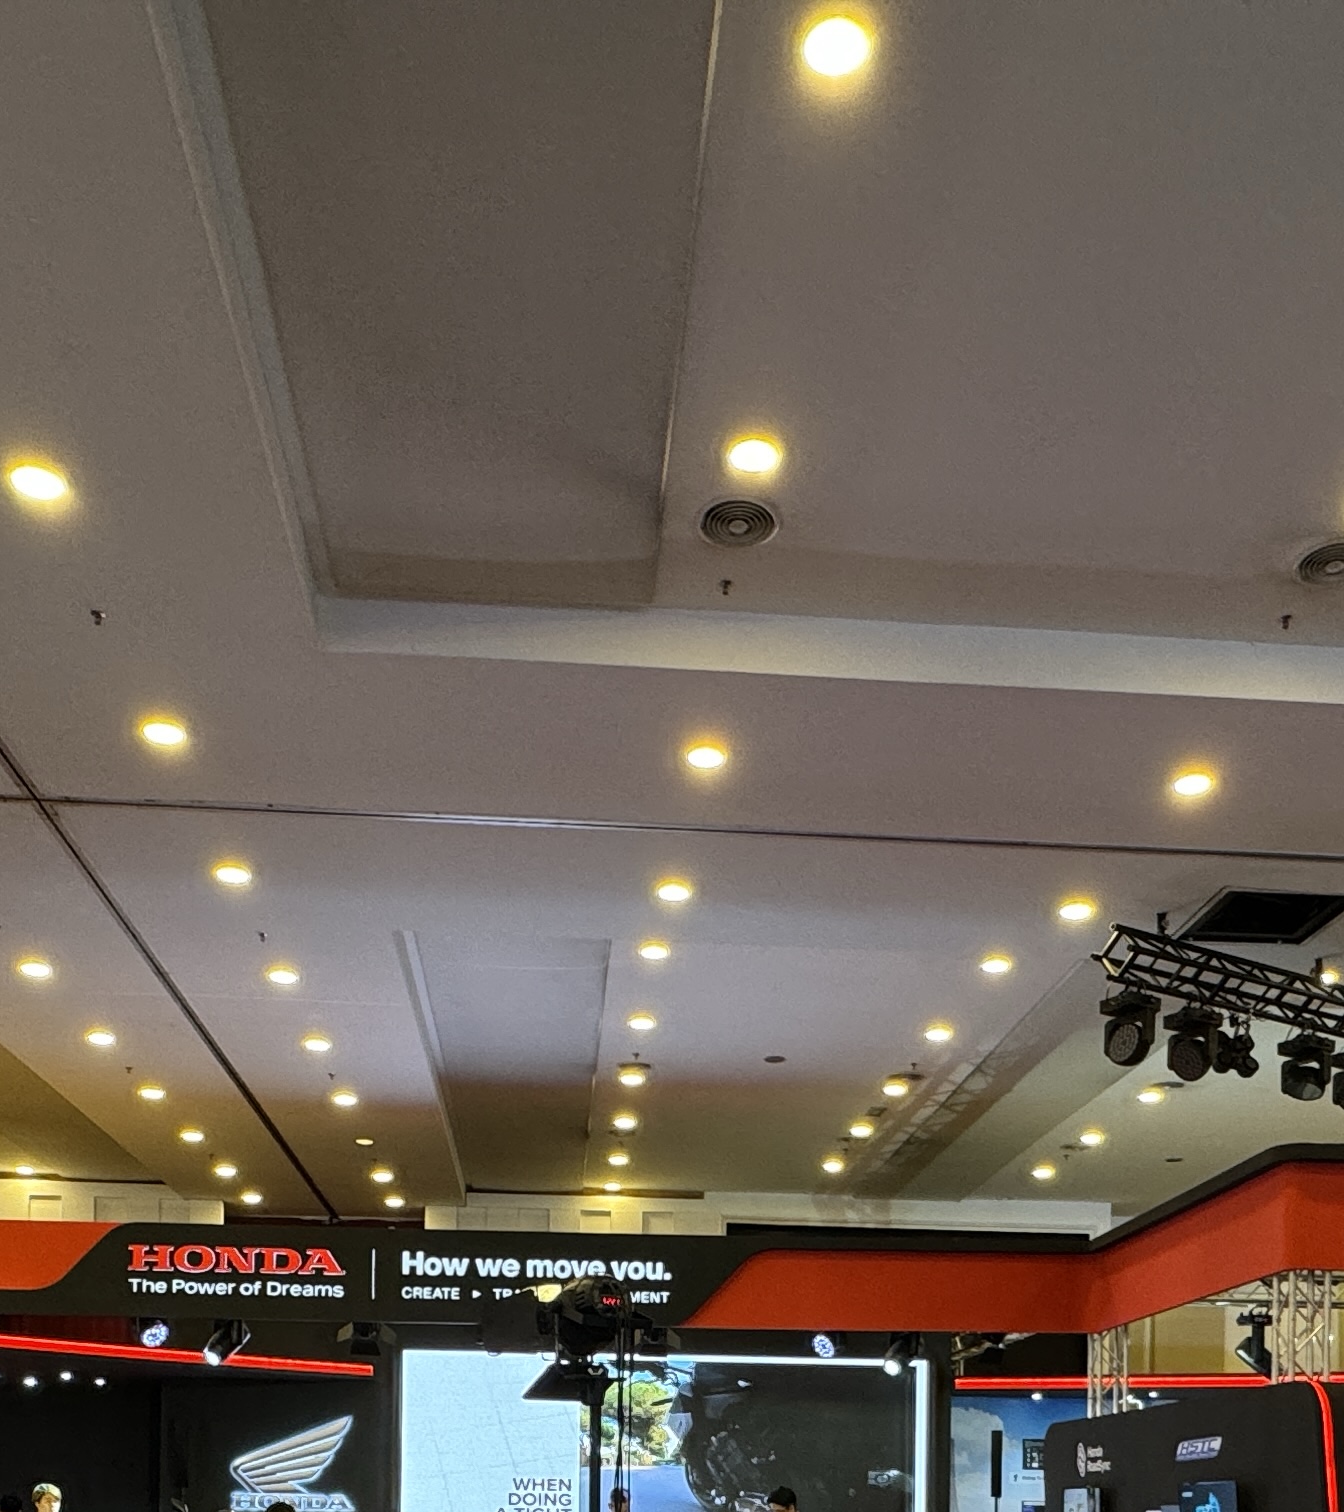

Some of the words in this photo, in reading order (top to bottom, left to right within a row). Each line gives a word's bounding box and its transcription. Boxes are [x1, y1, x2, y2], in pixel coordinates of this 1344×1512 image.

[127, 1244, 346, 1275] HONDA
[401, 1250, 470, 1277] How
[475, 1257, 521, 1277] we
[525, 1258, 606, 1280] move
[610, 1260, 673, 1281] you.
[128, 1278, 168, 1293] The
[172, 1279, 236, 1295] Power
[239, 1281, 262, 1296] of
[266, 1281, 345, 1298] Dreams
[401, 1286, 461, 1300] CREATE
[513, 1478, 572, 1491] WHEN
[508, 1493, 572, 1506] DOING
